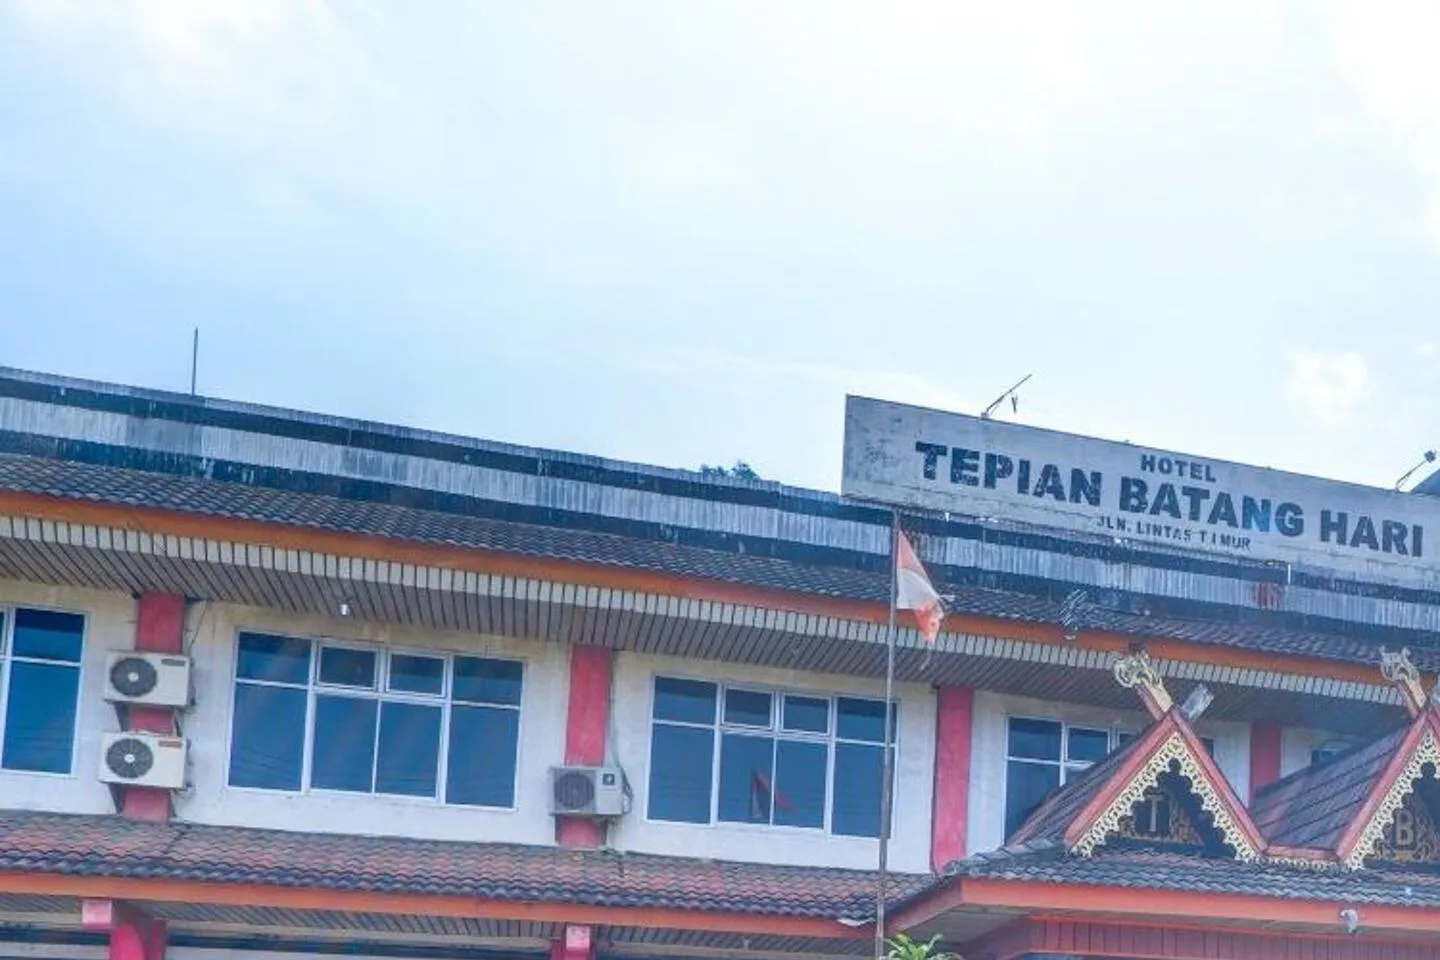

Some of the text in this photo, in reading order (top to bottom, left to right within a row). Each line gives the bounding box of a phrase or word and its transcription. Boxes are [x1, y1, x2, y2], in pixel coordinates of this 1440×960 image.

[1140, 454, 1216, 483] HOTEL
[915, 441, 1423, 557] TEPIAN BATANG HARI
[1136, 520, 1191, 542] LINTAS
[1395, 809, 1414, 846] B
